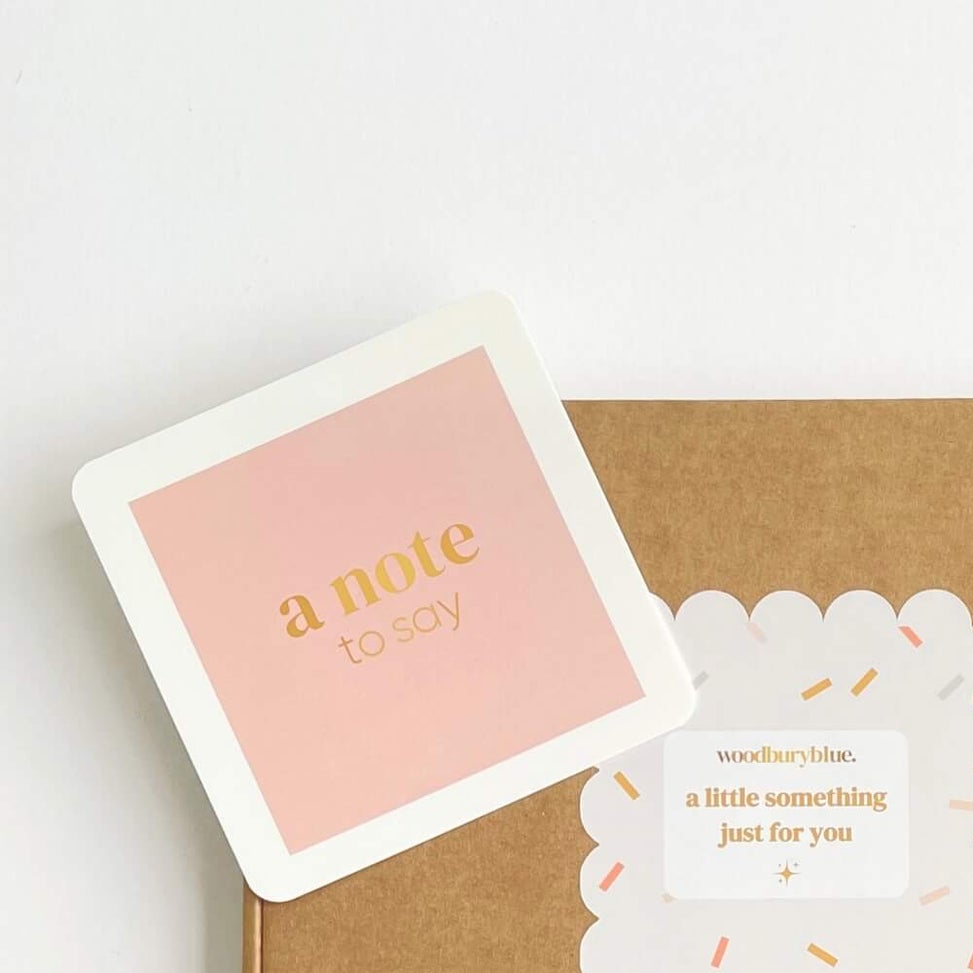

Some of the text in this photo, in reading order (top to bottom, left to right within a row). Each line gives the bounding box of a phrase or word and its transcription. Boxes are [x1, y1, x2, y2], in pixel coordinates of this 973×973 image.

[279, 523, 480, 638] a note
[337, 591, 460, 664] to say
[717, 746, 857, 768] woodburyblue.
[685, 786, 888, 812] a little something
[717, 821, 853, 848] just for you
